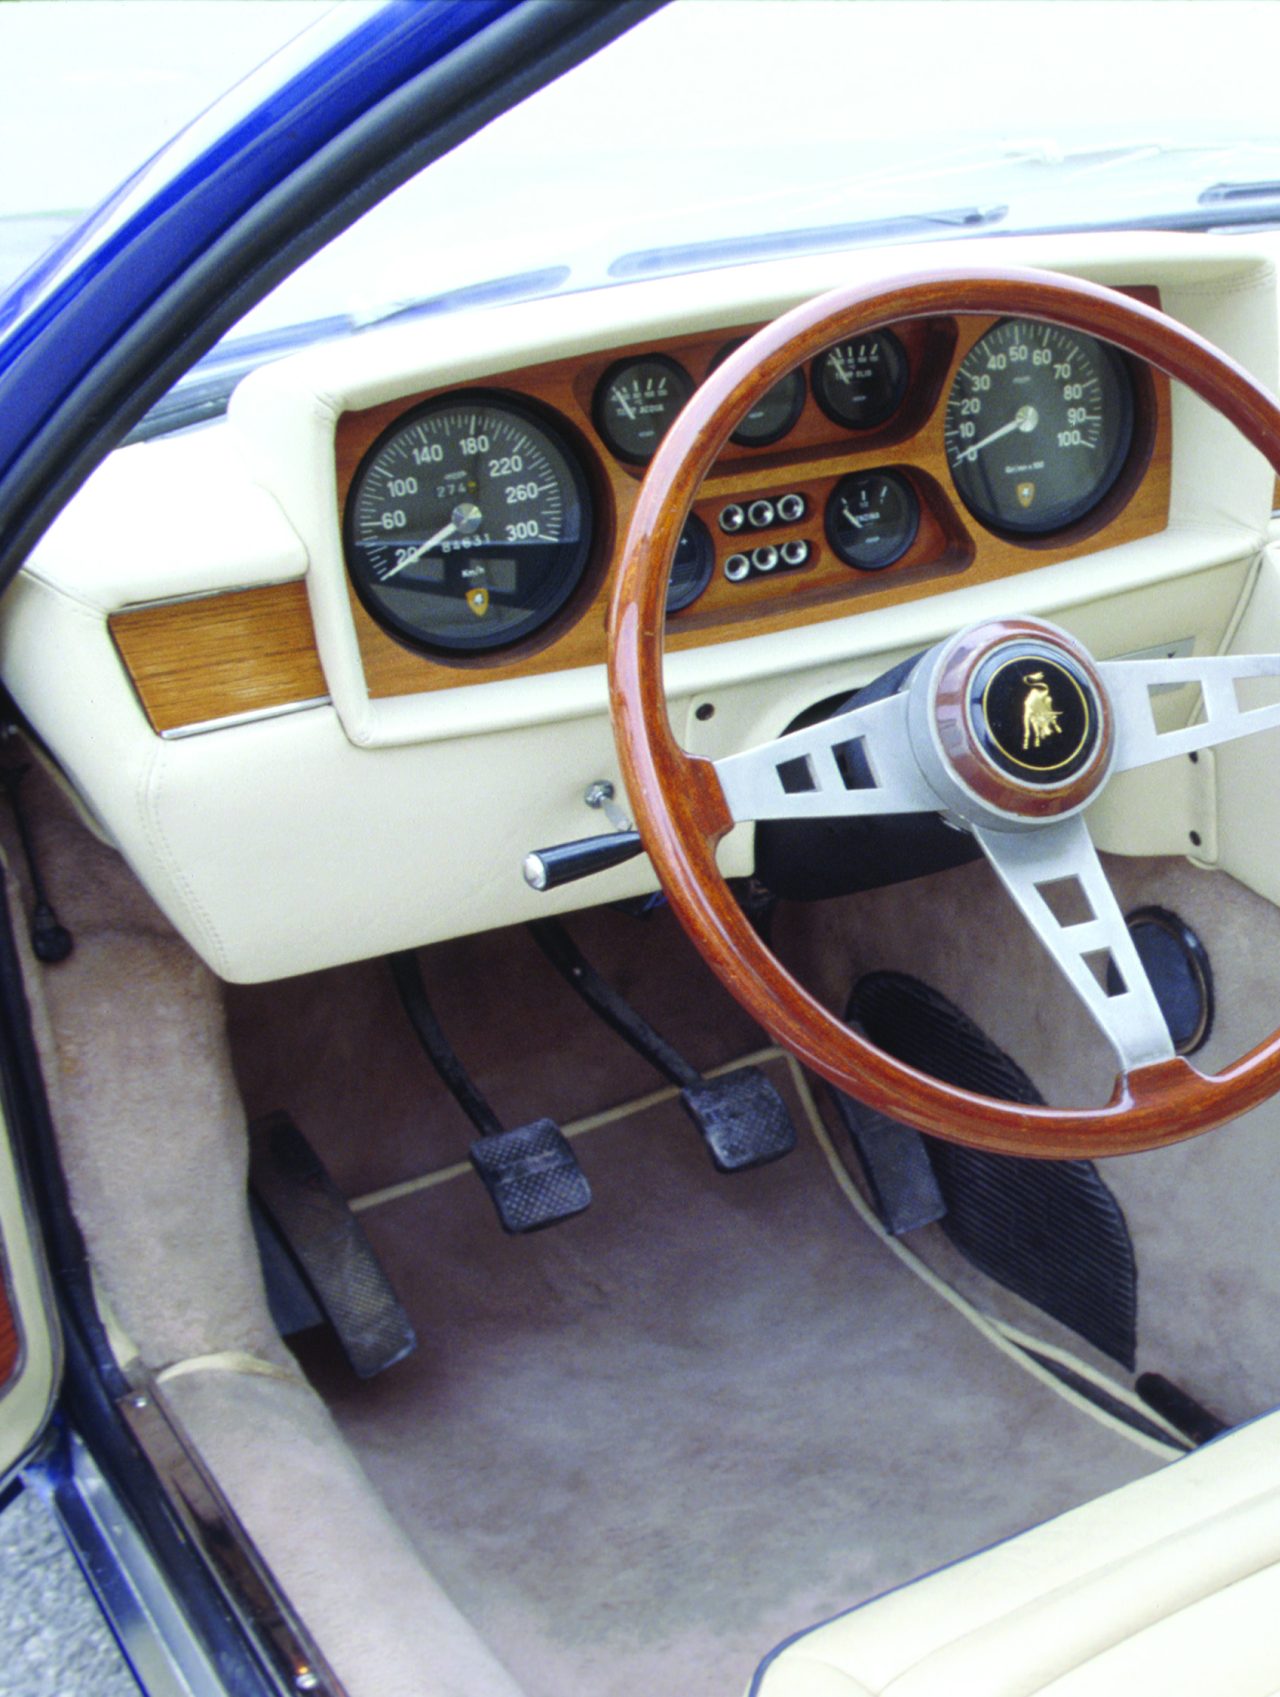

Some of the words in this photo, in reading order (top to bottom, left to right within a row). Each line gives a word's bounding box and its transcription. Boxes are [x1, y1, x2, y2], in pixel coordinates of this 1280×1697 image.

[987, 354, 1007, 370] 40
[1009, 345, 1028, 362] 50
[1032, 350, 1052, 366] 60
[1053, 364, 1072, 379] 70
[971, 374, 990, 391] 30
[1063, 384, 1082, 401] 80
[960, 398, 981, 415] 20
[1067, 408, 1086, 425] 90
[959, 422, 975, 438] 10
[459, 435, 490, 455] 180
[1057, 431, 1081, 447] 100
[413, 444, 444, 466] 140
[488, 455, 523, 477] 220
[387, 477, 418, 498] 100
[505, 482, 539, 504] 260
[380, 510, 406, 530] 60
[505, 520, 539, 542] 300
